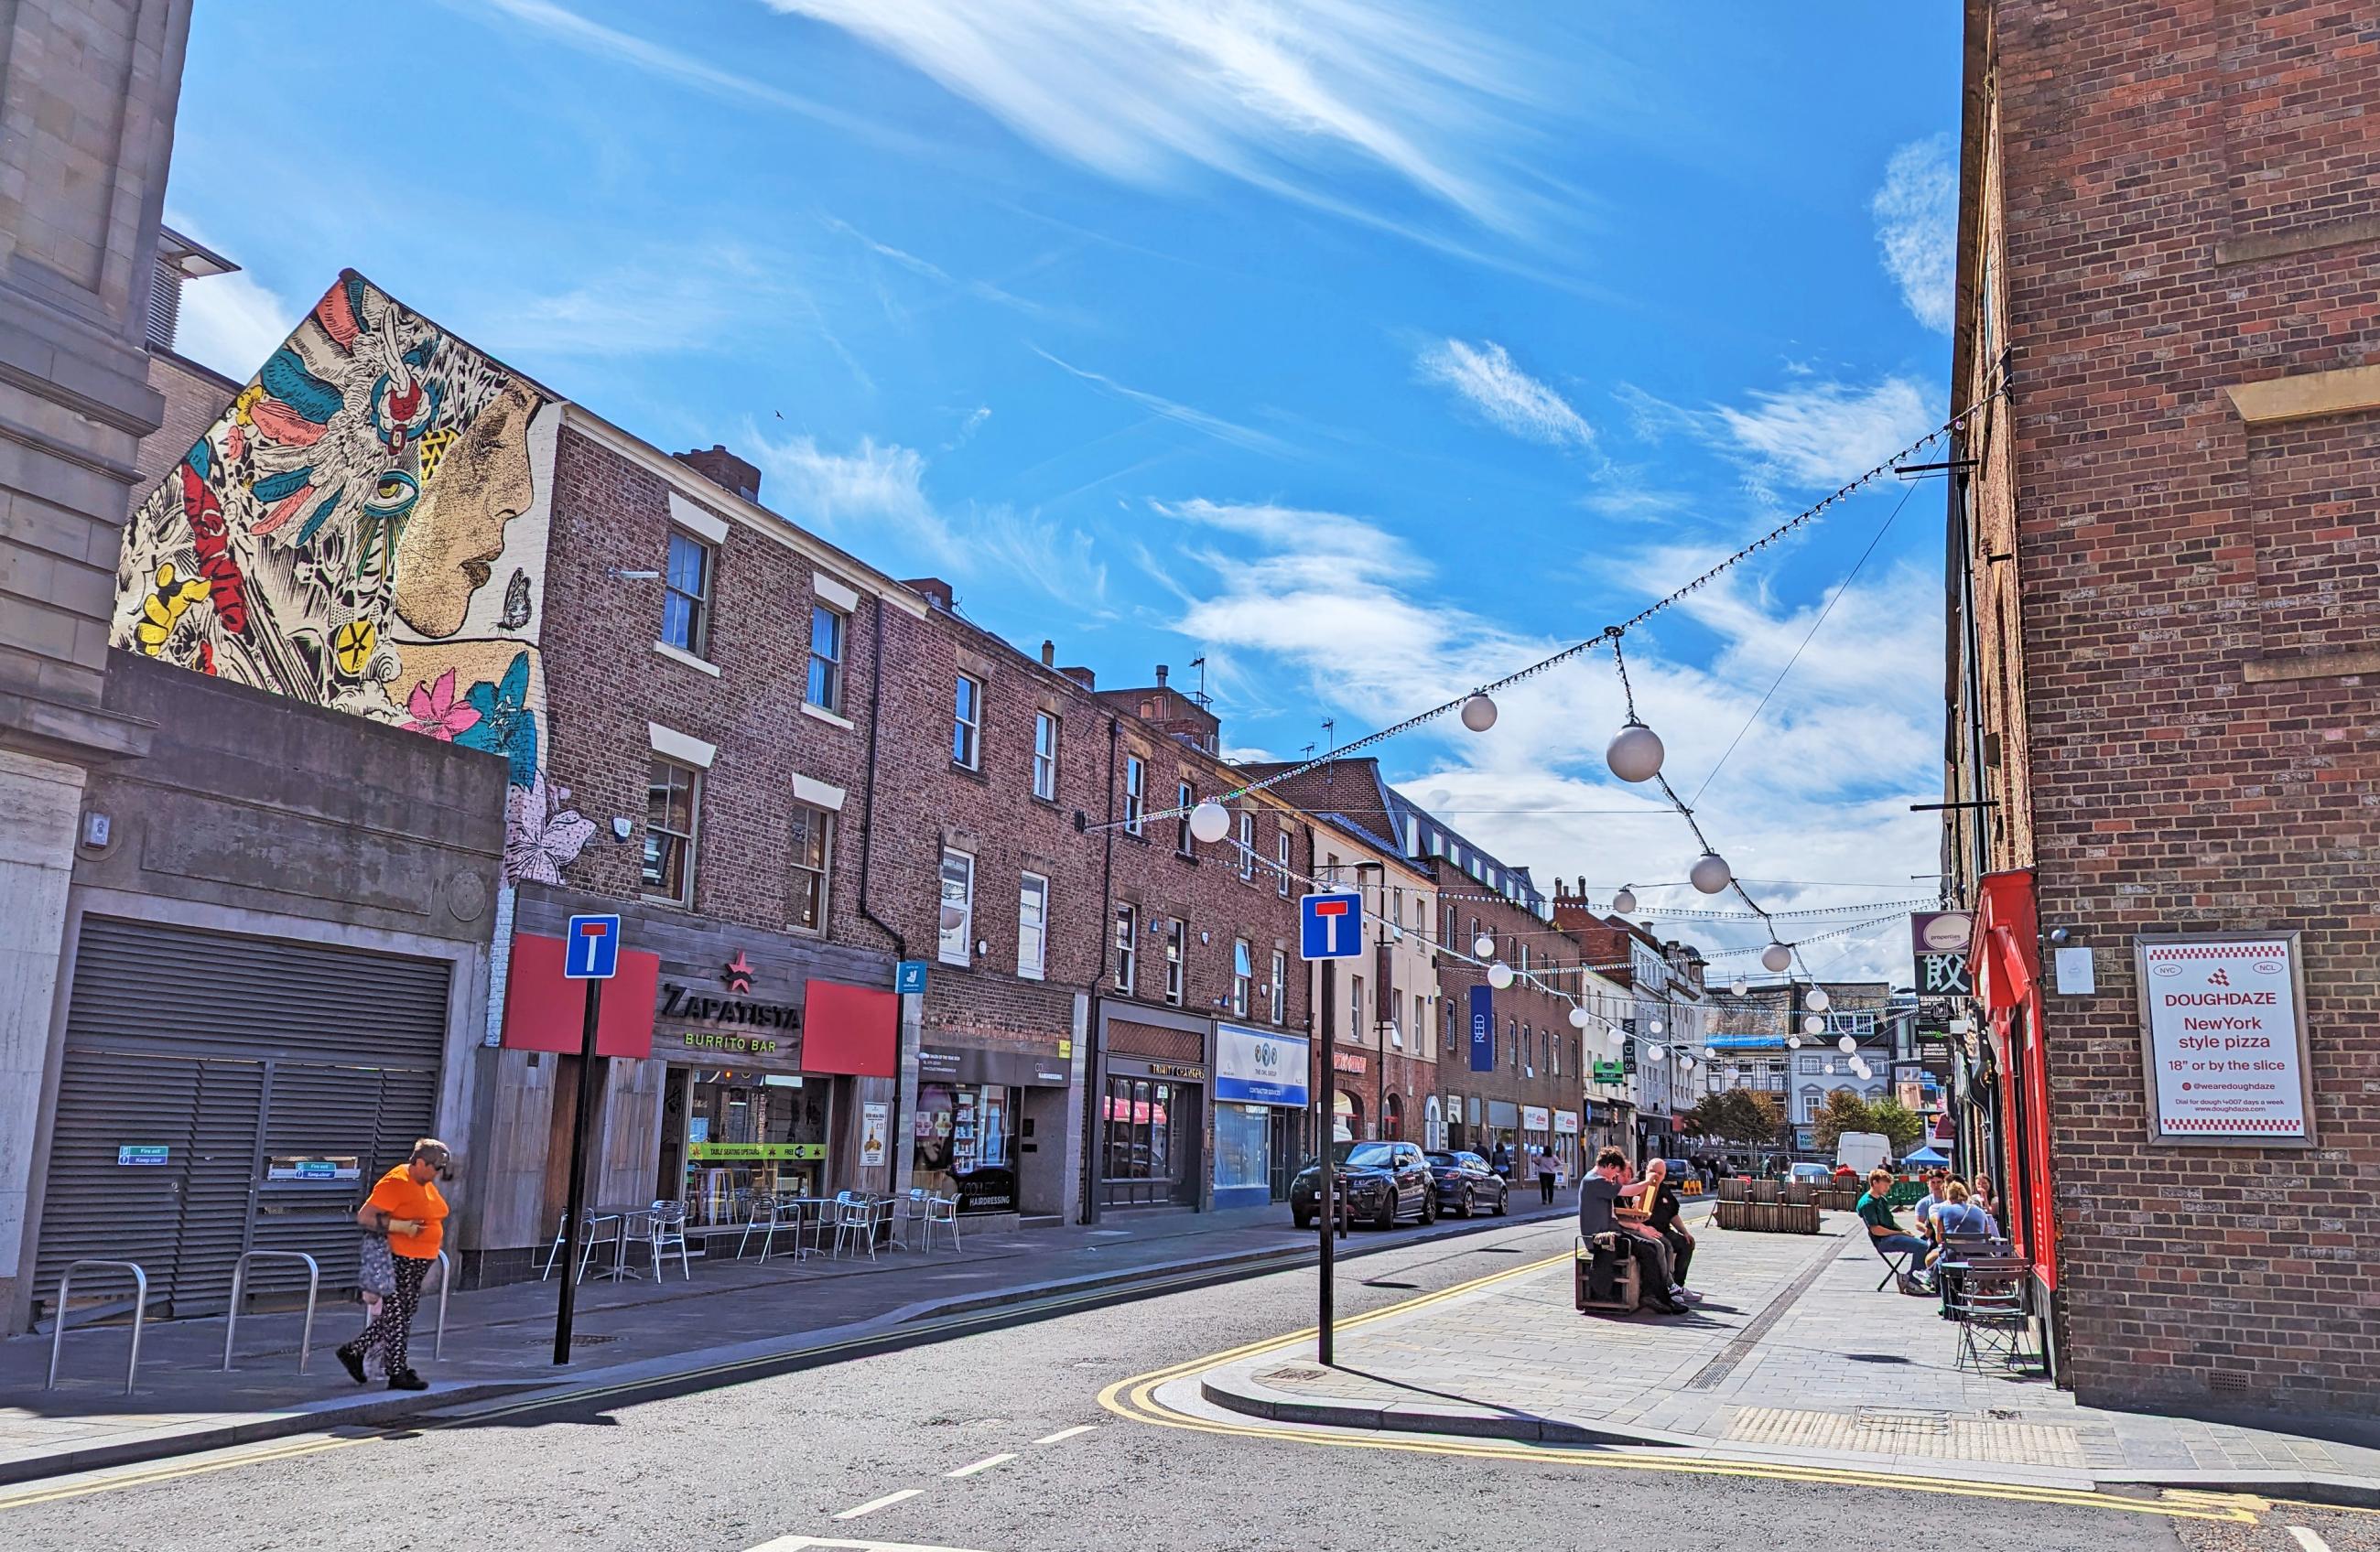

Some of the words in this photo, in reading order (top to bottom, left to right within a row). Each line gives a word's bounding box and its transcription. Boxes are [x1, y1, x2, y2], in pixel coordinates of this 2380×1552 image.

[662, 983, 801, 1029] ZAPATISTA
[2165, 992, 2277, 1007] DOUGHDAZE
[1475, 1014, 1485, 1042] REED
[2184, 1017, 2262, 1030] NewYork
[685, 1033, 746, 1050] BURRITO
[751, 1040, 776, 1052] BAR
[2179, 1035, 2220, 1051] style
[2224, 1035, 2270, 1051] pizza
[1152, 1064, 1172, 1075] TRINITY
[2191, 1062, 2206, 1071] or
[2209, 1060, 2224, 1072] by
[2228, 1060, 2250, 1071] the
[2253, 1060, 2286, 1071] slice
[2193, 1083, 2276, 1092] @wearedoughdaze
[969, 1195, 1010, 1207] HAIRDRESSING
